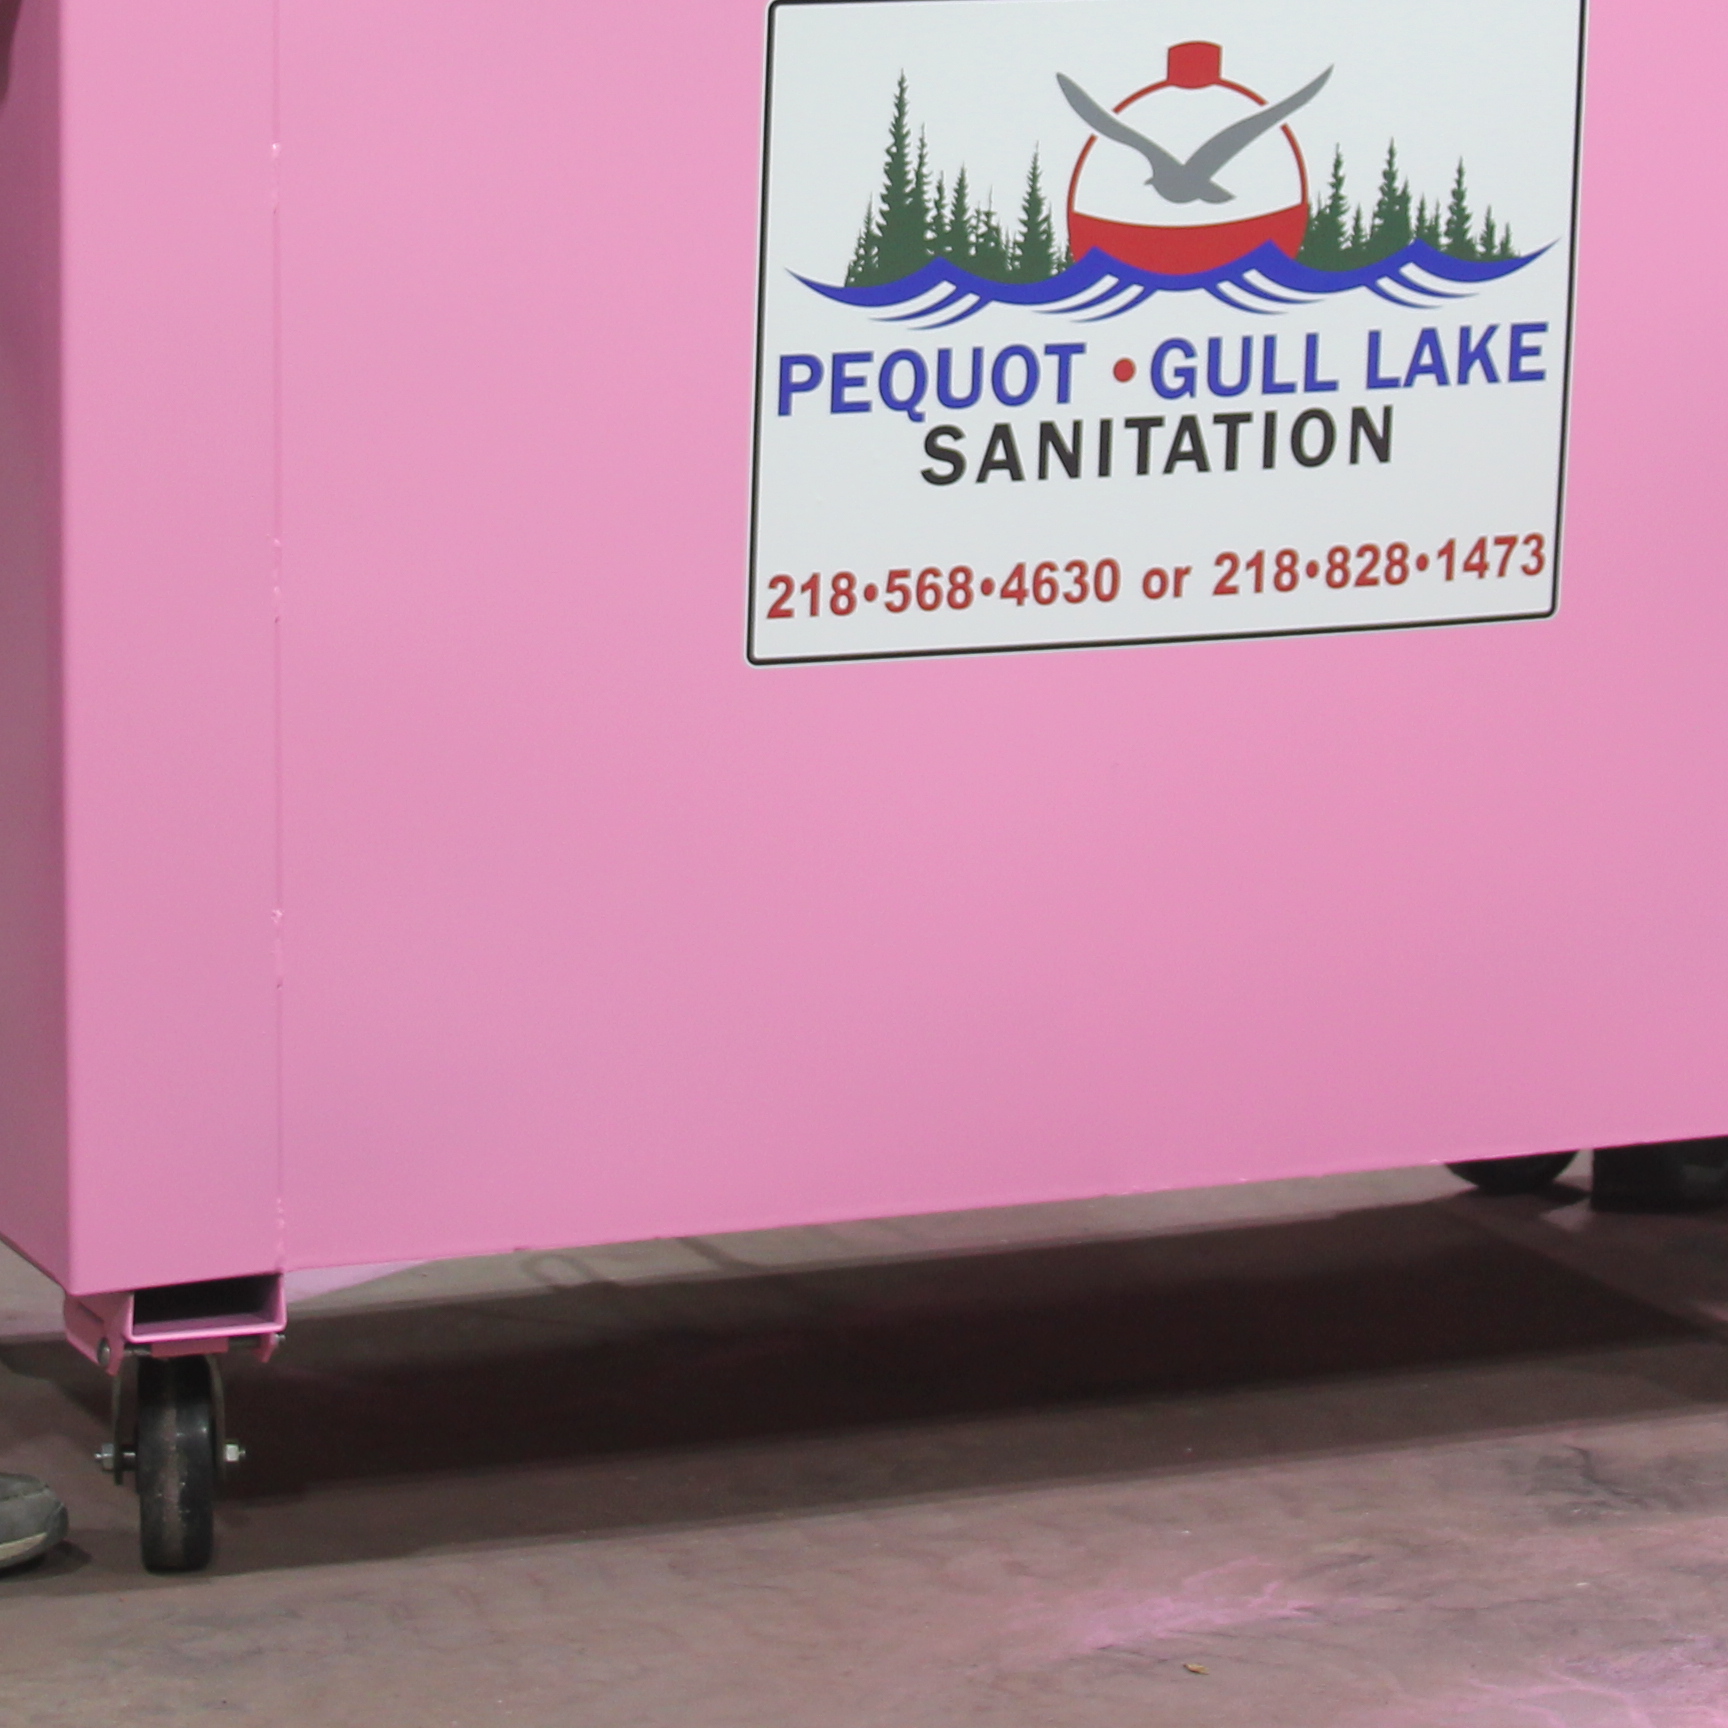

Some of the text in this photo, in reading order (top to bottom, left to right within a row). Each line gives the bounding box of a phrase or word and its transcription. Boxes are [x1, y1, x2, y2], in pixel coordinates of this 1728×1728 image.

[776, 321, 1549, 422] PEQUOT GULL LAKE
[920, 405, 1396, 487] SANITATION
[1142, 558, 1191, 600] or
